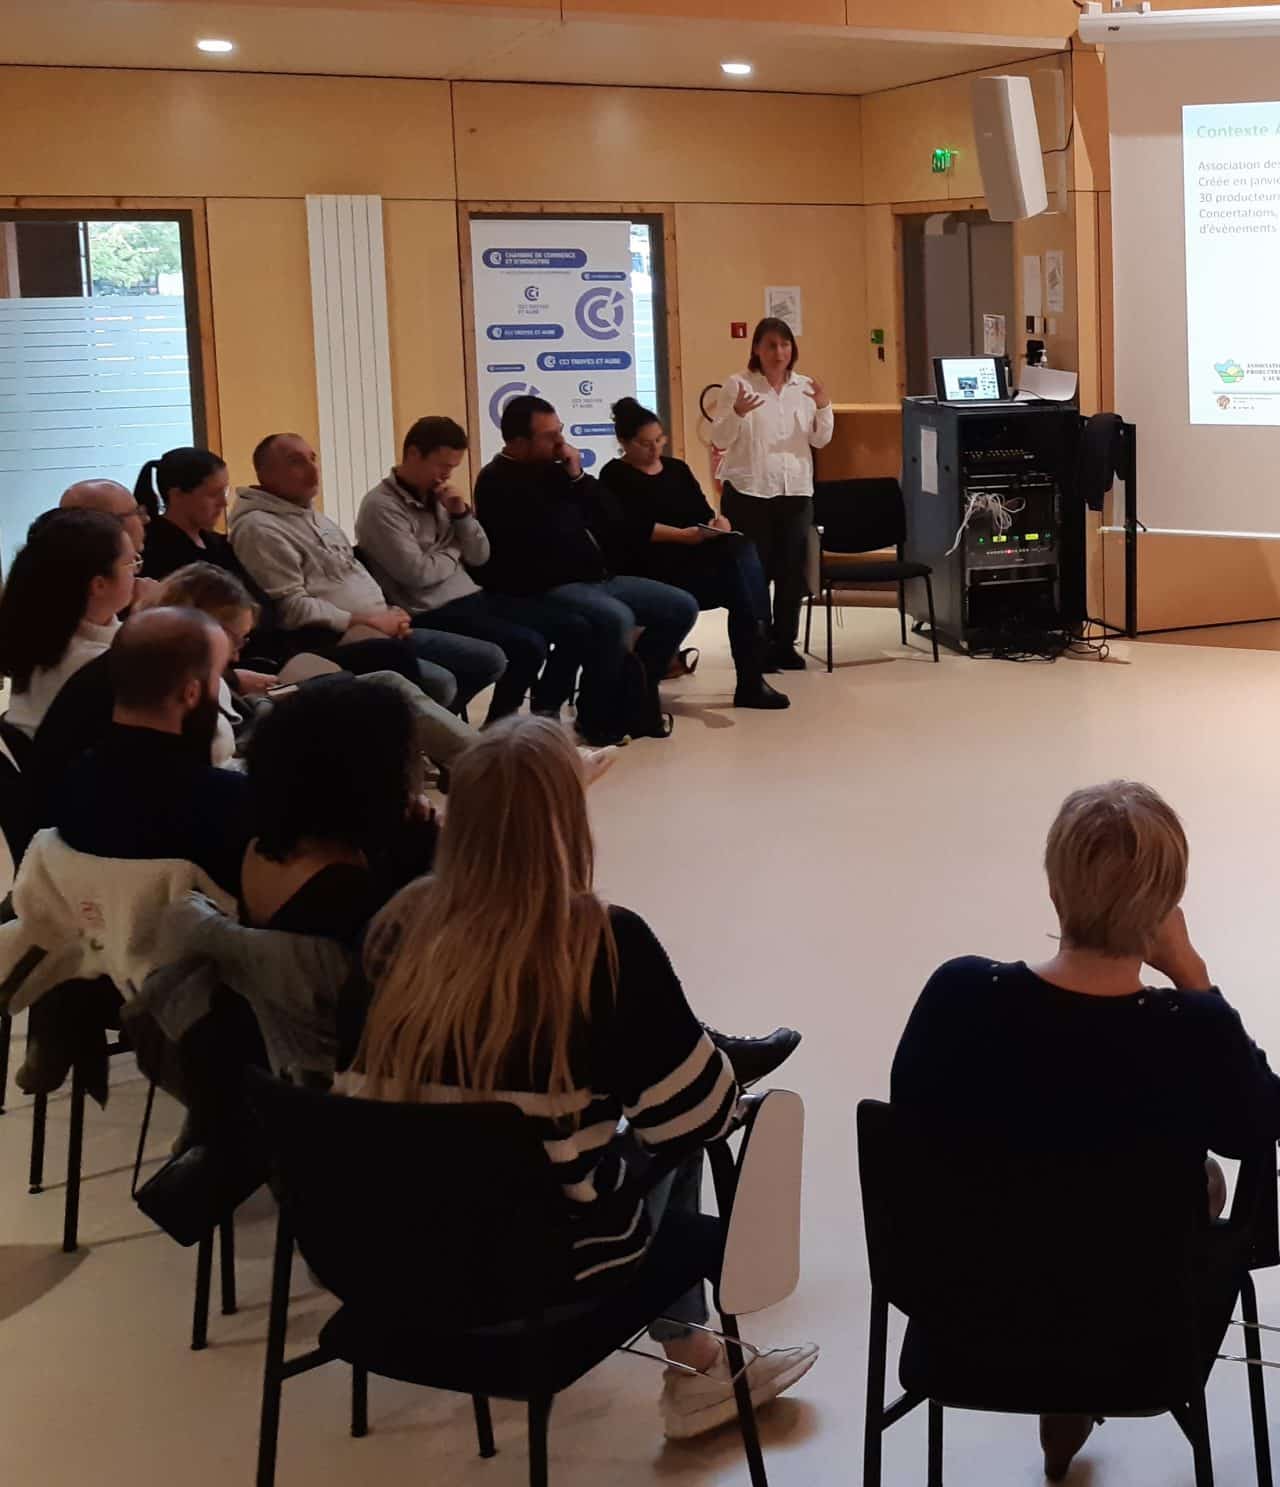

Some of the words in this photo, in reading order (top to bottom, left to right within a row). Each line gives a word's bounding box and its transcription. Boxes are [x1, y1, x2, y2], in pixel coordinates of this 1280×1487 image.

[1197, 125, 1269, 139] Contexte
[1198, 160, 1260, 171] Association
[1198, 176, 1230, 187] Créée
[1232, 177, 1247, 186] en
[1199, 192, 1213, 203] 30
